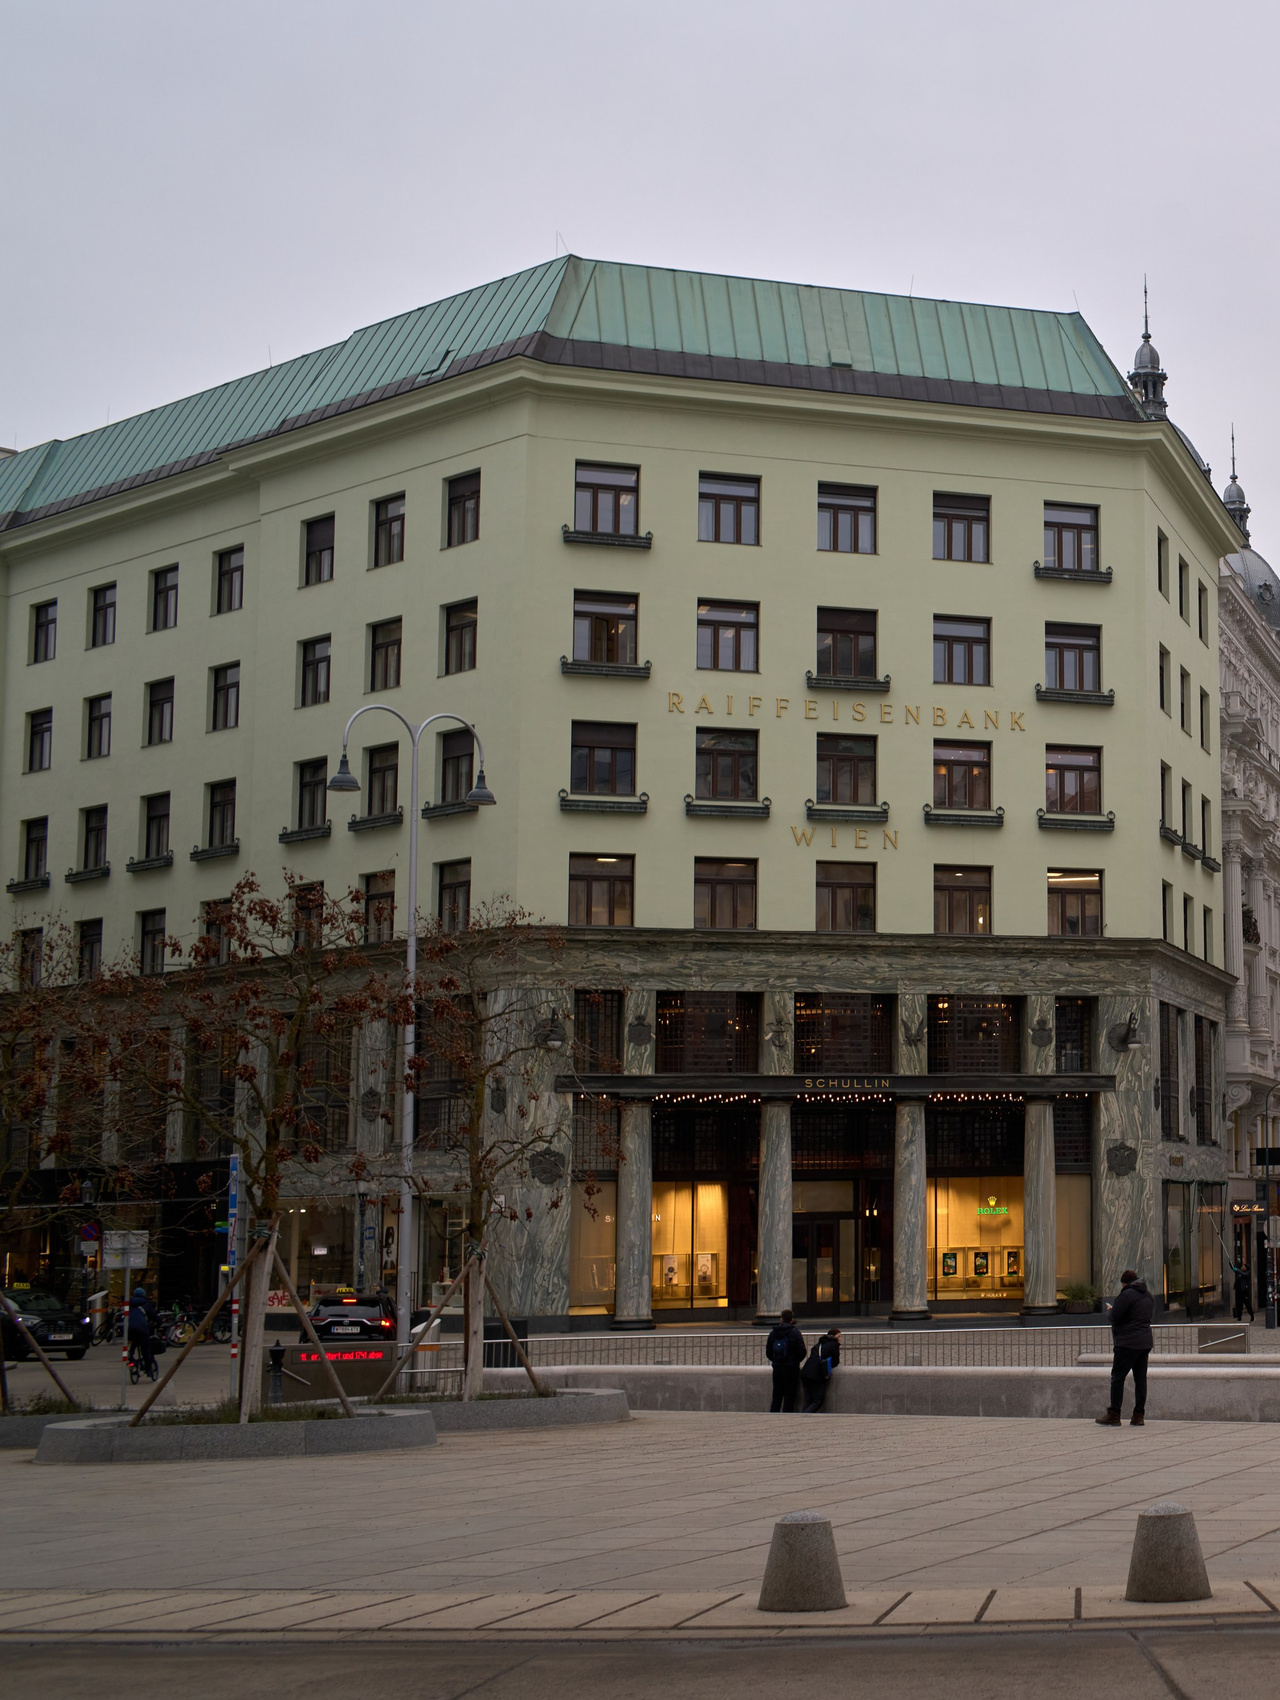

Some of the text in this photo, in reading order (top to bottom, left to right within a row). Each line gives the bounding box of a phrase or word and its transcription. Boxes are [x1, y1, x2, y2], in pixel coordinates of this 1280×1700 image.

[668, 691, 1026, 731] RAIFFEISENBANK
[790, 825, 899, 850] WIEN
[804, 1079, 890, 1088] SCHULLIN
[977, 1207, 1008, 1215] ROLEX
[267, 1290, 290, 1307] SALE
